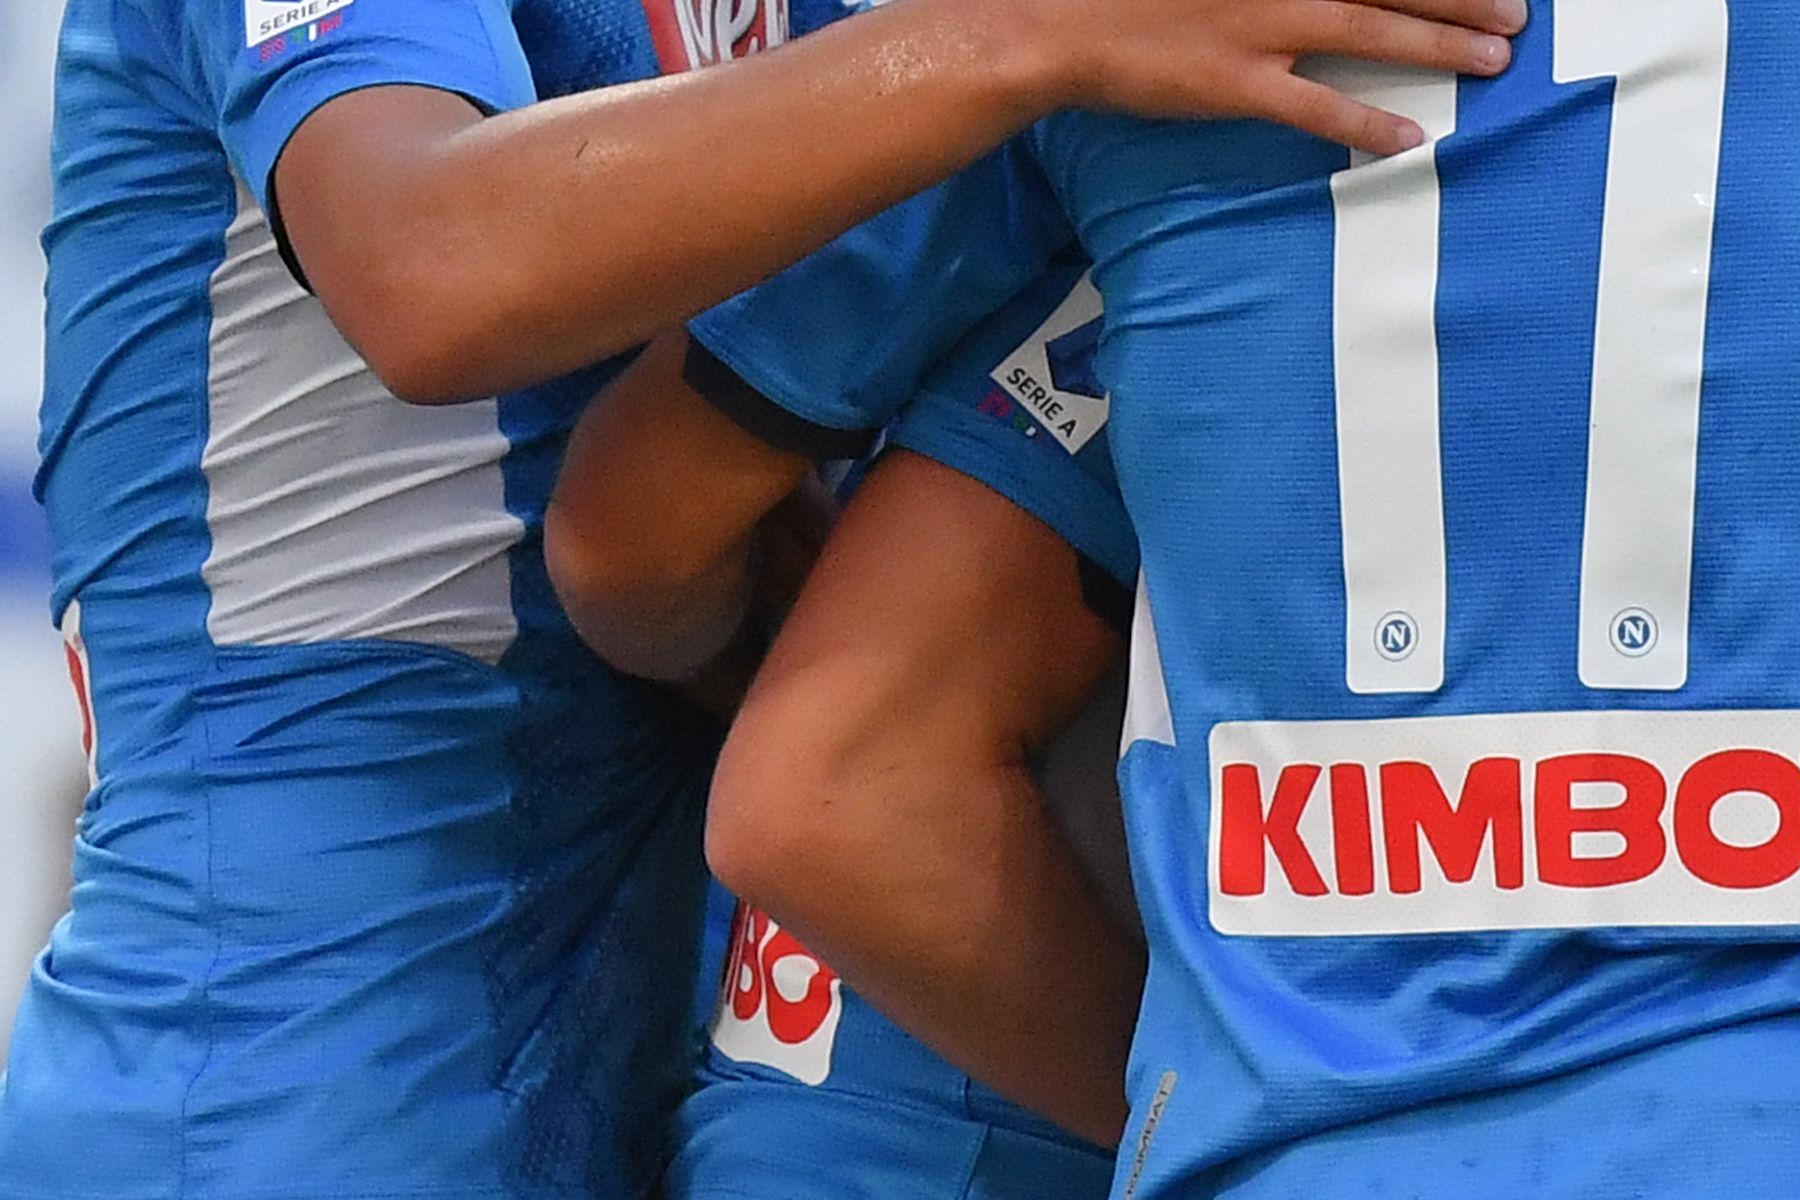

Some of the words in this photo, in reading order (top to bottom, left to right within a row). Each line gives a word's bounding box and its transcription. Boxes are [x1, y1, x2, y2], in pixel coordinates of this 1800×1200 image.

[259, 1, 320, 36] SERIE
[1006, 367, 1064, 422] SERIE
[1057, 418, 1078, 440] A
